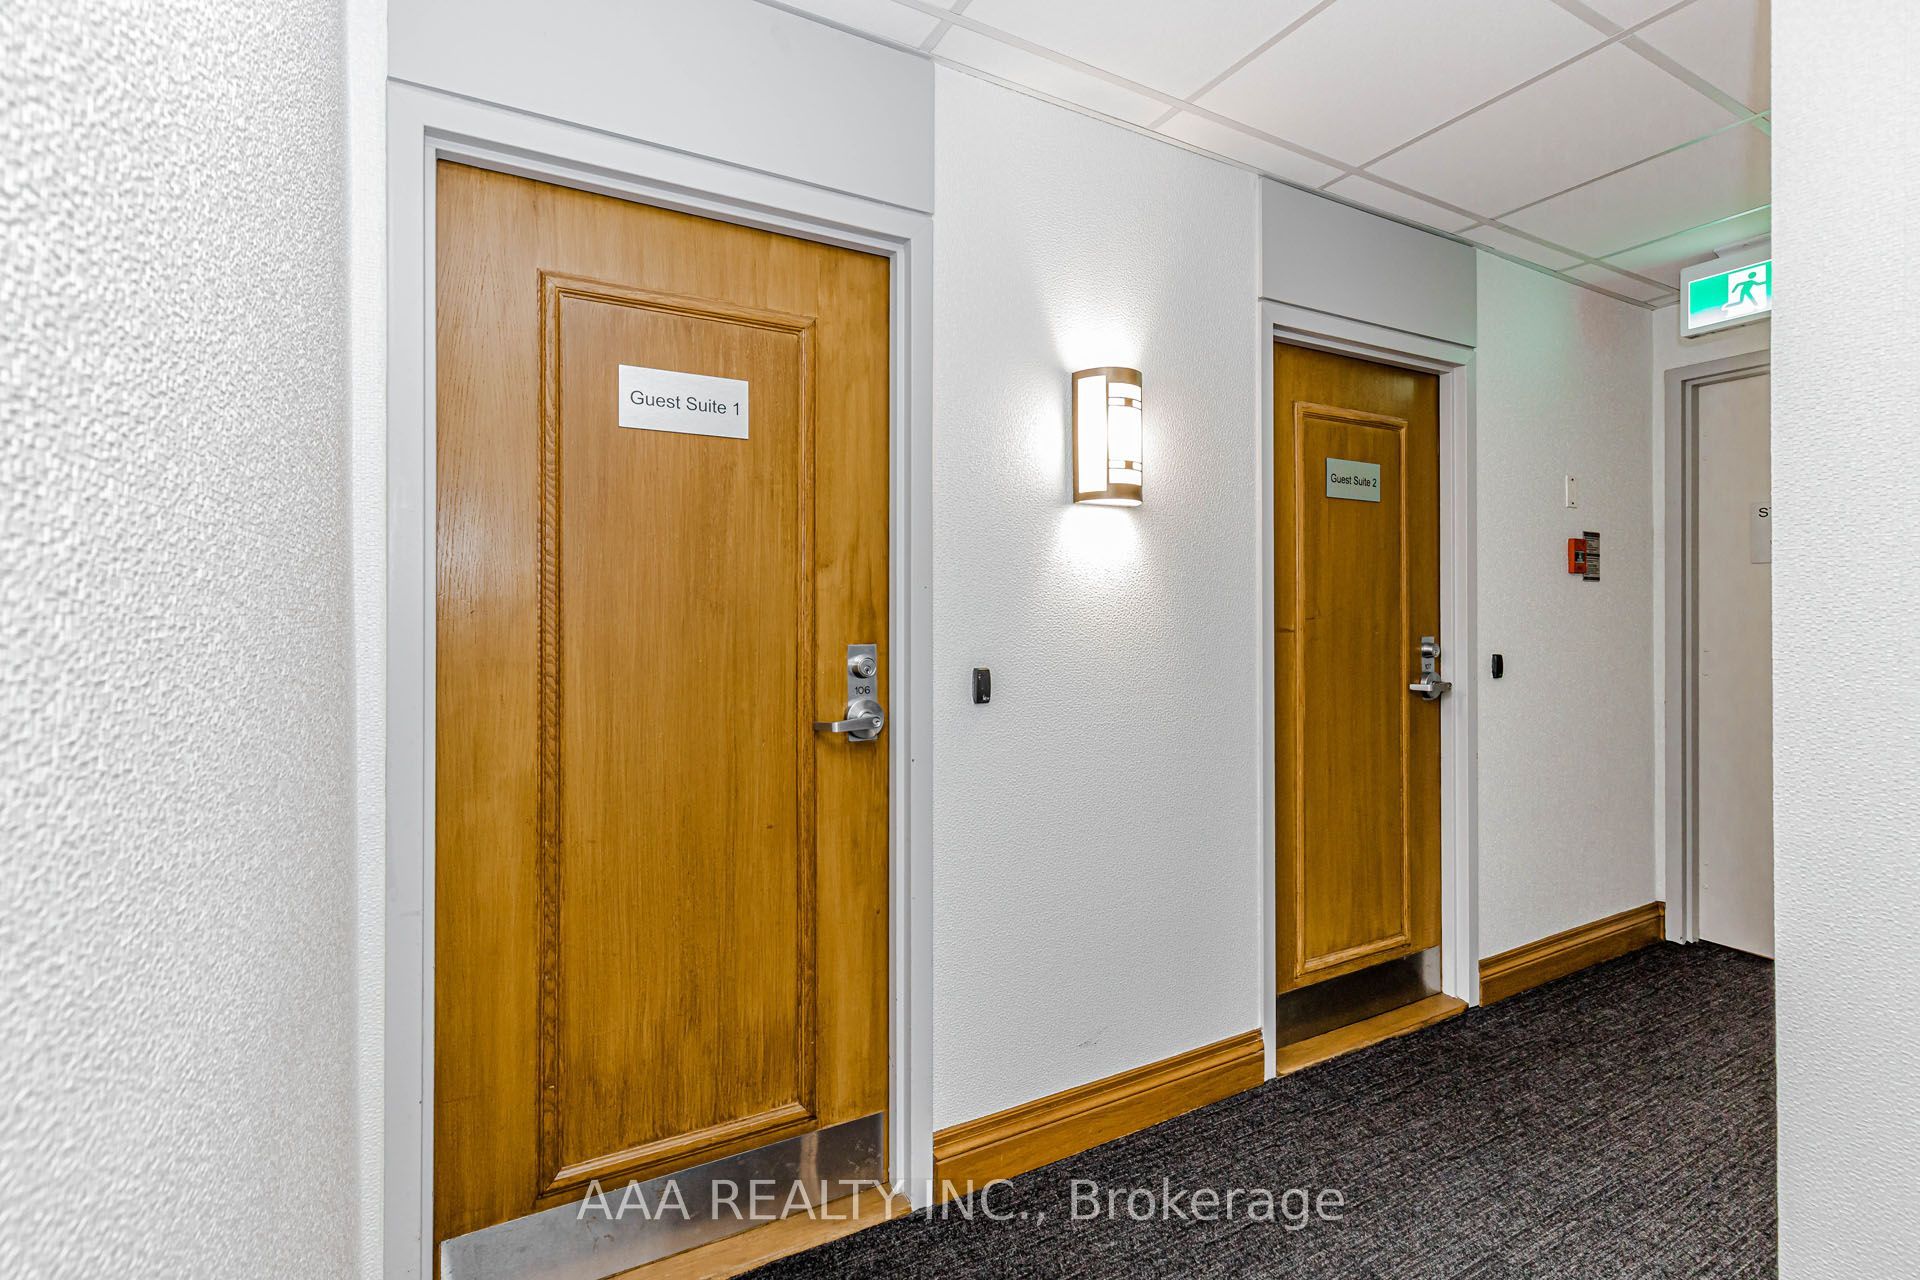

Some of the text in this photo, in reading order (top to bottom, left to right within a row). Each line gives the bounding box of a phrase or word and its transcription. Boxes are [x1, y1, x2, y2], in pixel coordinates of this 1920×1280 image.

[630, 390, 740, 416] Guest Suite 1
[1331, 473, 1377, 487] Guest Suite 2
[1758, 506, 1772, 518] S
[854, 685, 871, 695] 106
